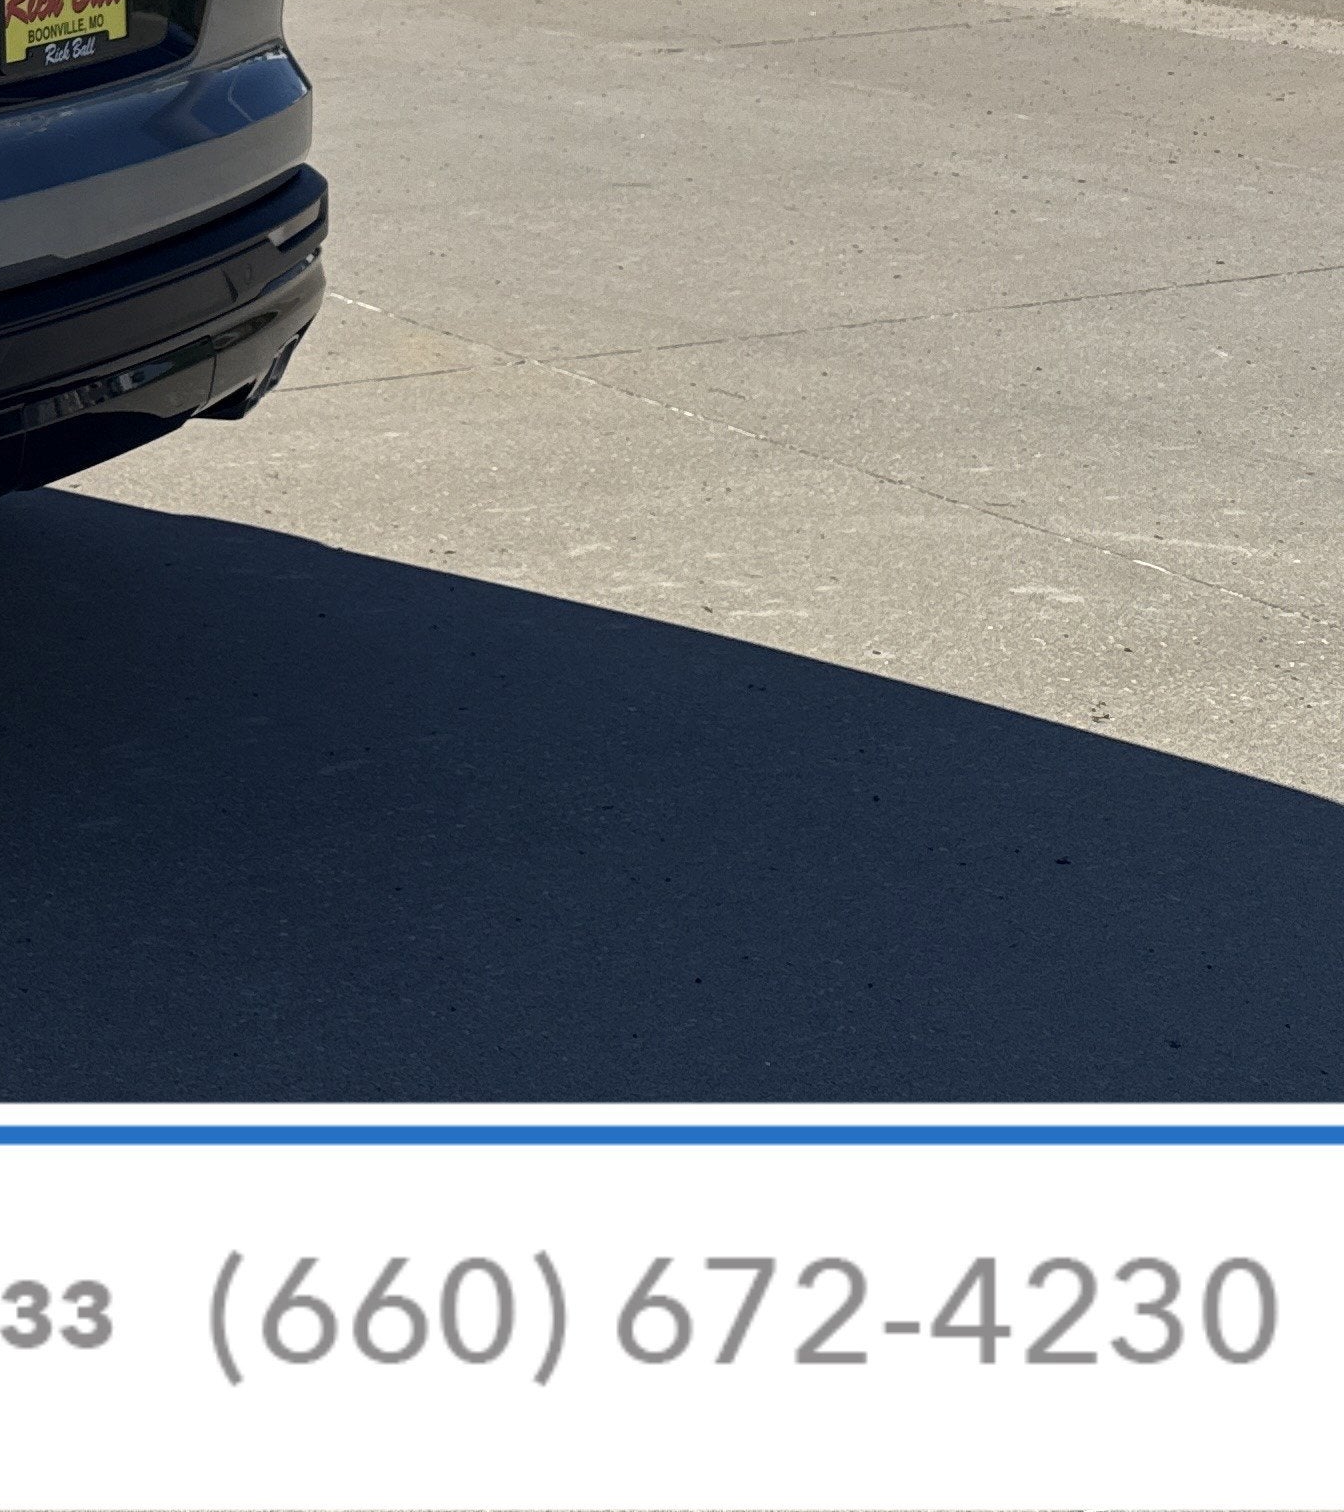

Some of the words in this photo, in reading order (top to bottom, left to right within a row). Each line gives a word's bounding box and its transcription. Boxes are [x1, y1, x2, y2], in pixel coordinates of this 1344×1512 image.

[28, 18, 87, 43] BOONVILLE,
[89, 14, 105, 29] MO
[44, 42, 71, 66] Rick
[72, 36, 96, 60] Ball
